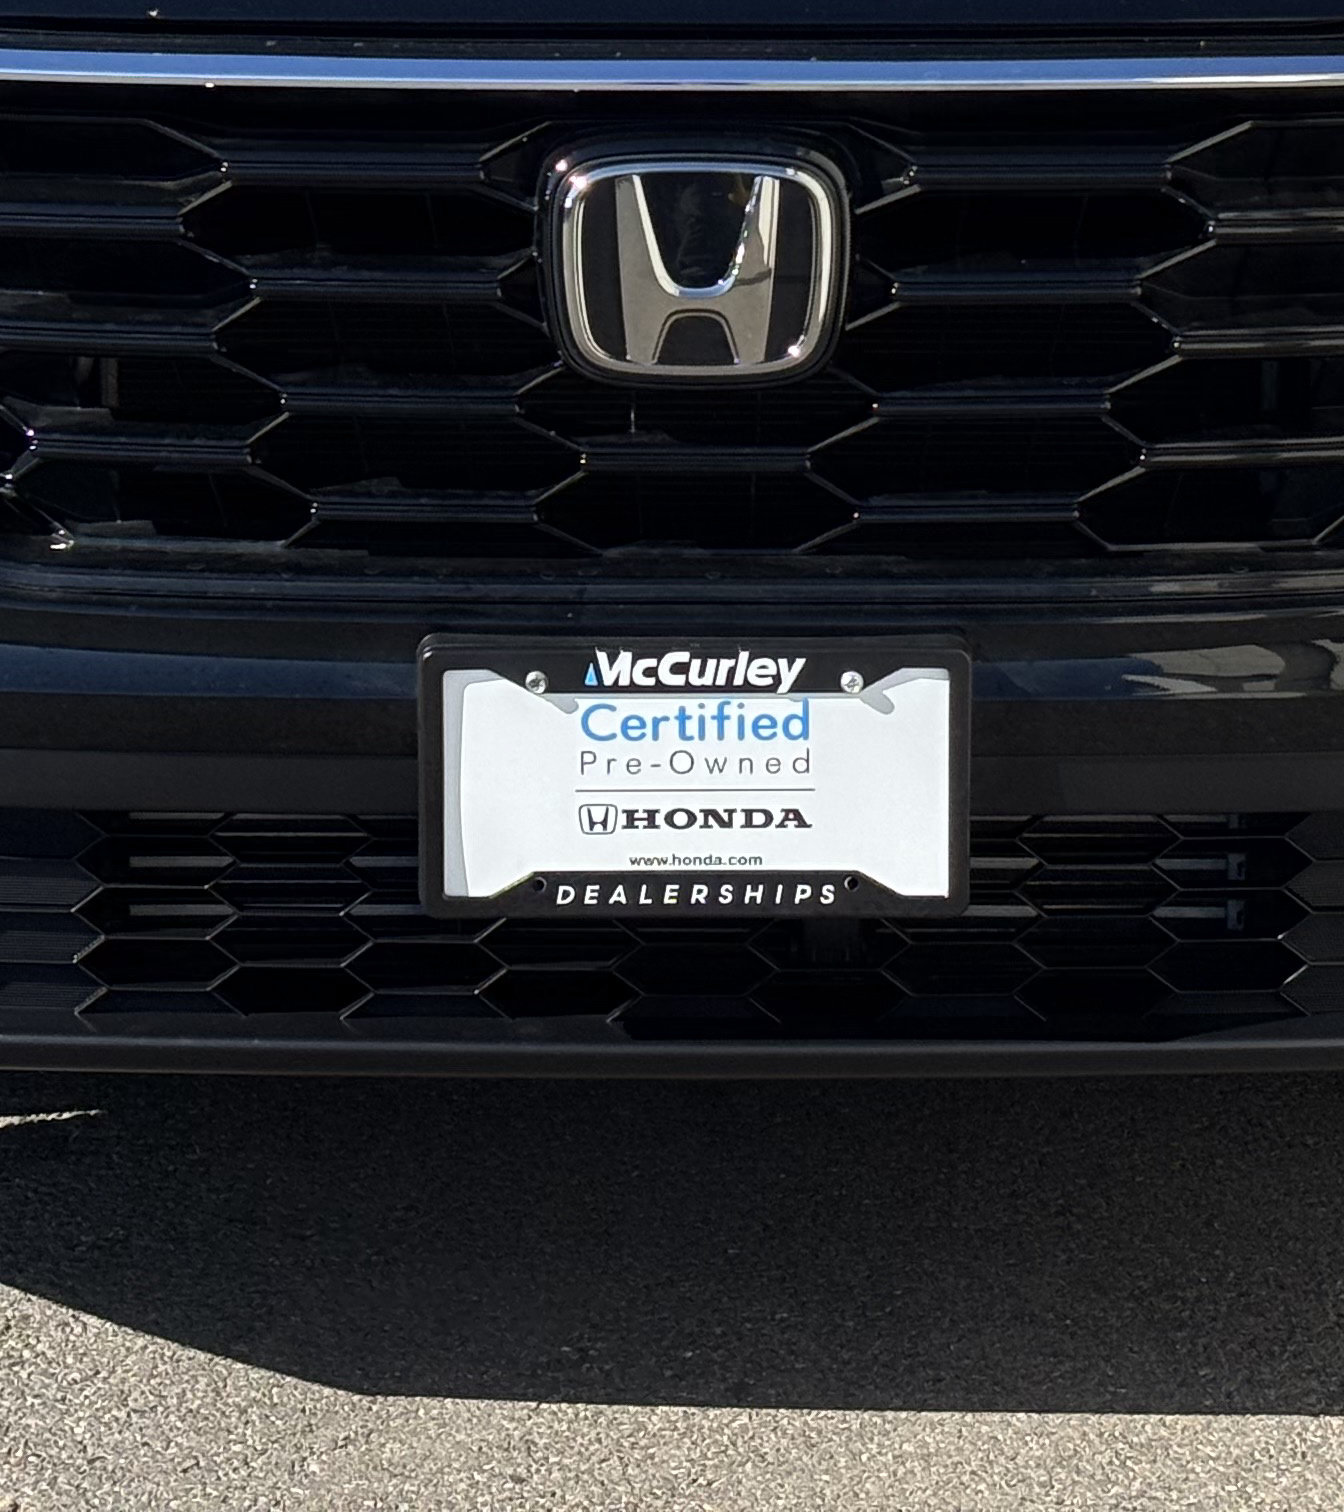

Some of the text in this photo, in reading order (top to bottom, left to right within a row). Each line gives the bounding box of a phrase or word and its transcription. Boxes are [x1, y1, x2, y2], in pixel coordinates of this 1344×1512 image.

[584, 649, 806, 694] McCurley
[580, 696, 810, 741] Certified
[580, 748, 810, 775] Pre-Owned
[621, 807, 813, 830] HONDA
[628, 853, 763, 866] www.honda.com
[556, 884, 835, 905] DEALERSHIPS
